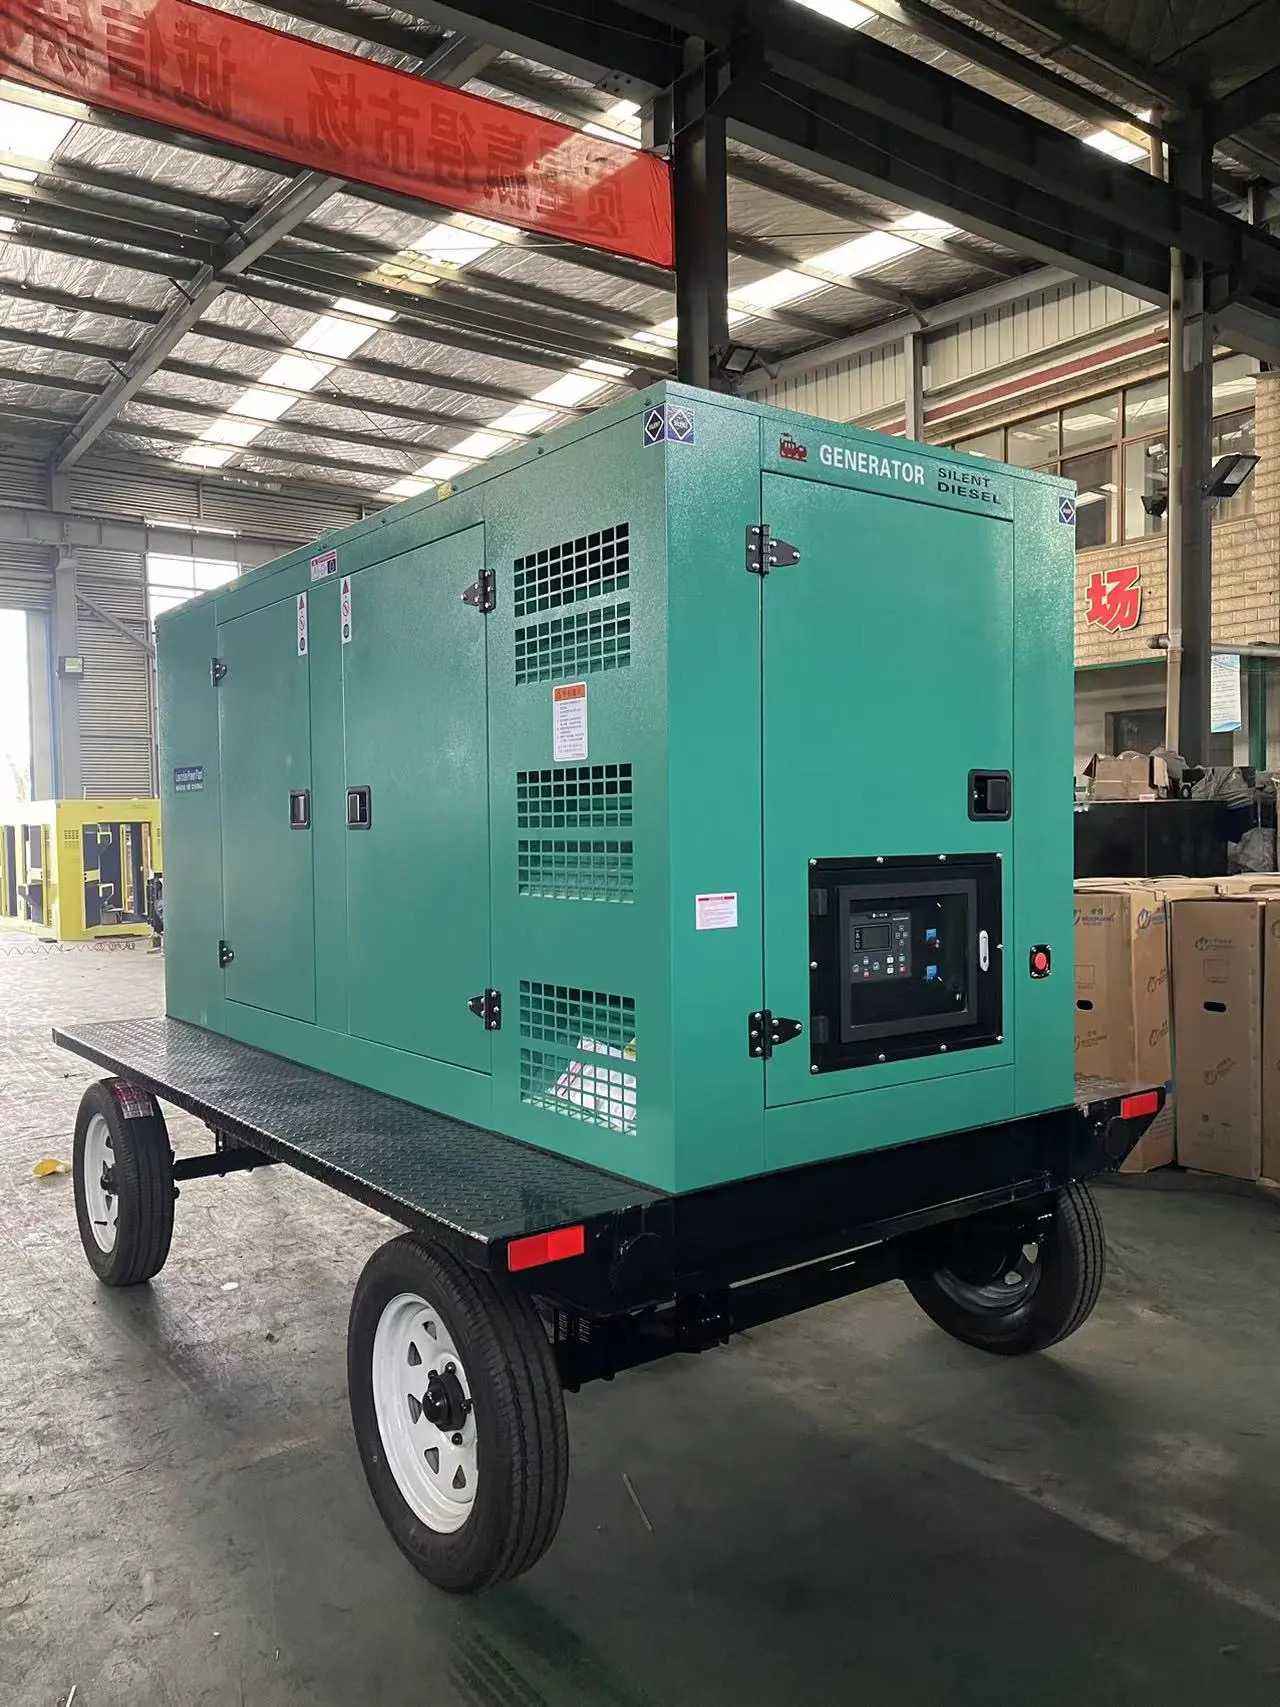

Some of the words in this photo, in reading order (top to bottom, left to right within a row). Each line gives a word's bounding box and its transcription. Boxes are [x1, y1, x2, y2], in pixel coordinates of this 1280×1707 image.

[820, 444, 925, 485] GENERATOR
[938, 467, 991, 488] SILENT
[937, 481, 1001, 505] DIESEL
[1084, 565, 1141, 633] 场
